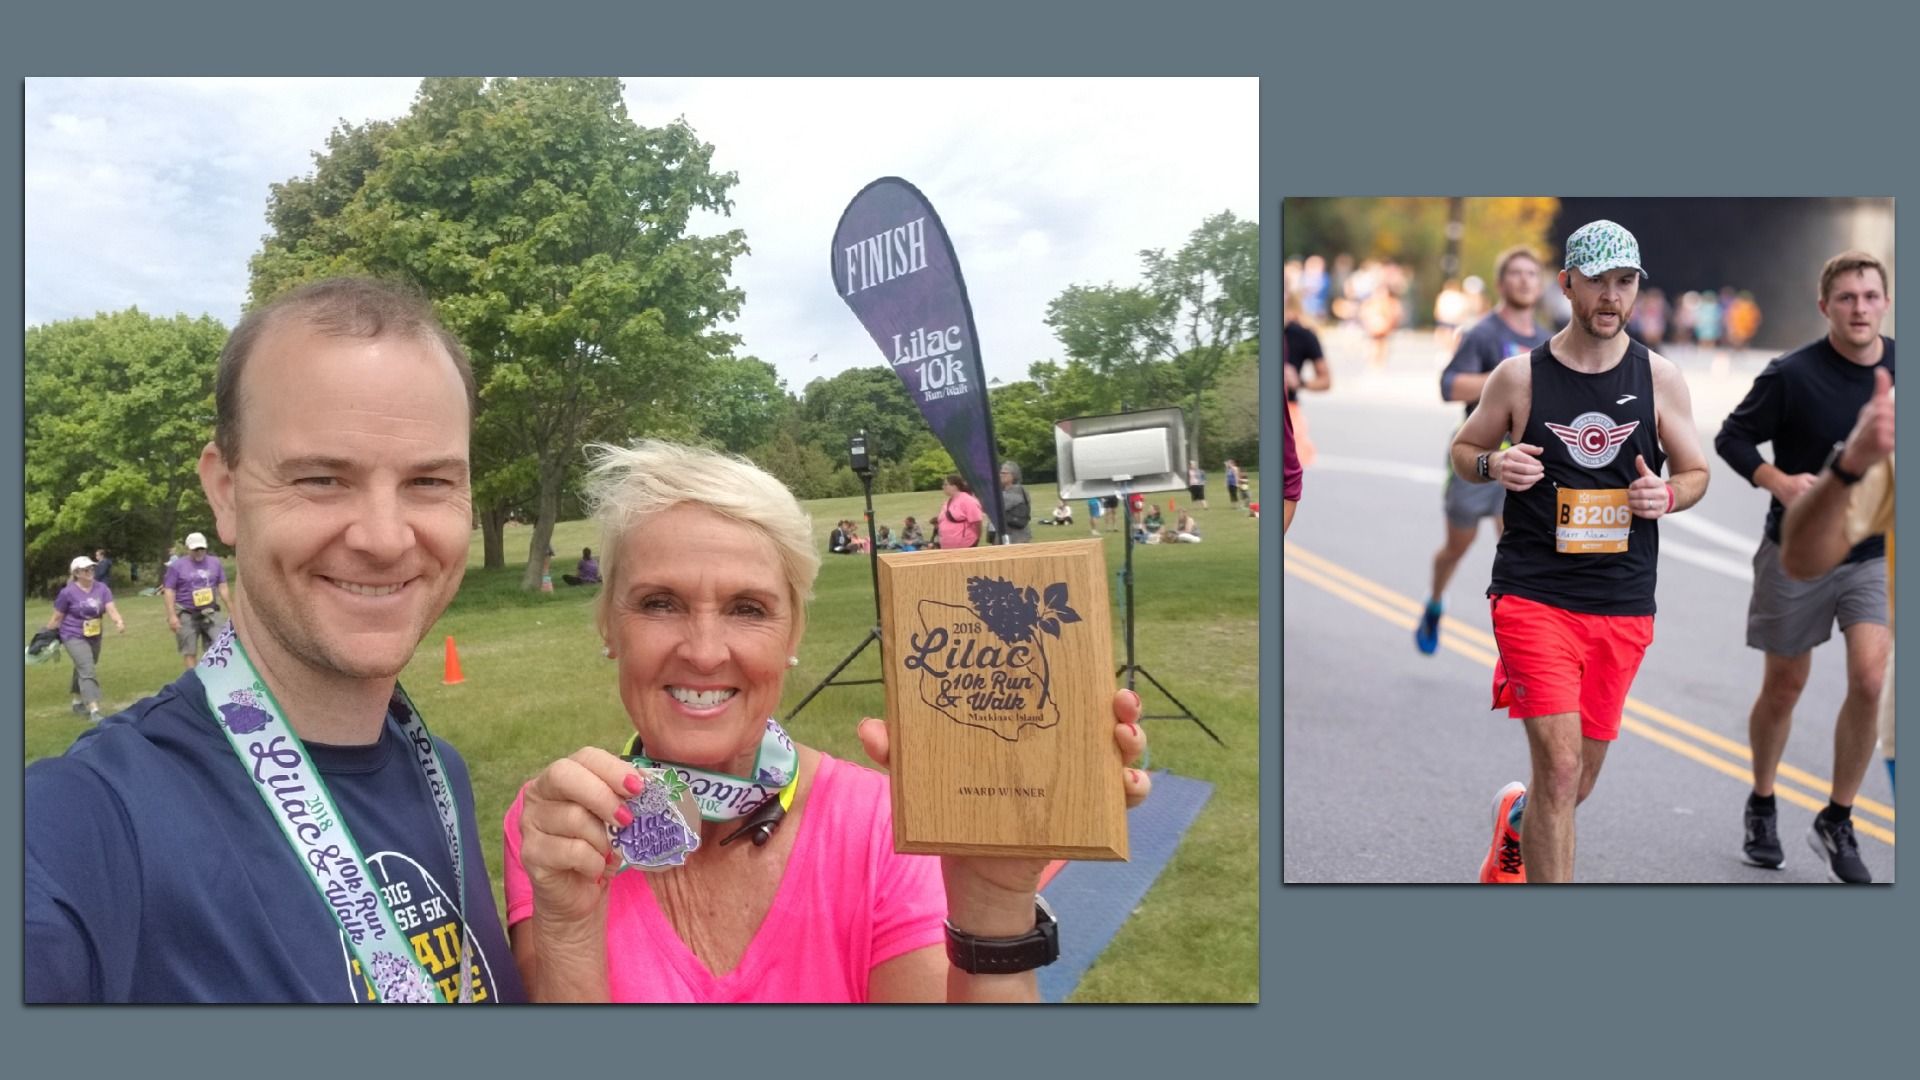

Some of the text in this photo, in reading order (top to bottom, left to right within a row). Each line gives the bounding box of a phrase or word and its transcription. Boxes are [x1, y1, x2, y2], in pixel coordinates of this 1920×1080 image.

[845, 217, 928, 296] FINISH
[892, 325, 962, 366] Lilac
[915, 353, 967, 391] 10k
[1585, 431, 1601, 450] C
[1573, 504, 1630, 525] 8206
[953, 623, 982, 634] 2018
[904, 627, 1036, 678] Lilac
[936, 679, 1026, 711] & Walk
[953, 671, 1033, 695] 10k Run
[968, 712, 1044, 723] Mackinac Island
[249, 736, 317, 846] Lilac
[409, 726, 448, 821] Lilac
[998, 787, 1045, 798] WINNER
[305, 794, 334, 833] 2018
[308, 845, 340, 876] &
[325, 879, 366, 945] Walk
[335, 856, 387, 941] 10k Run
[394, 896, 447, 931] SE 5K
[436, 965, 488, 1003] HE
